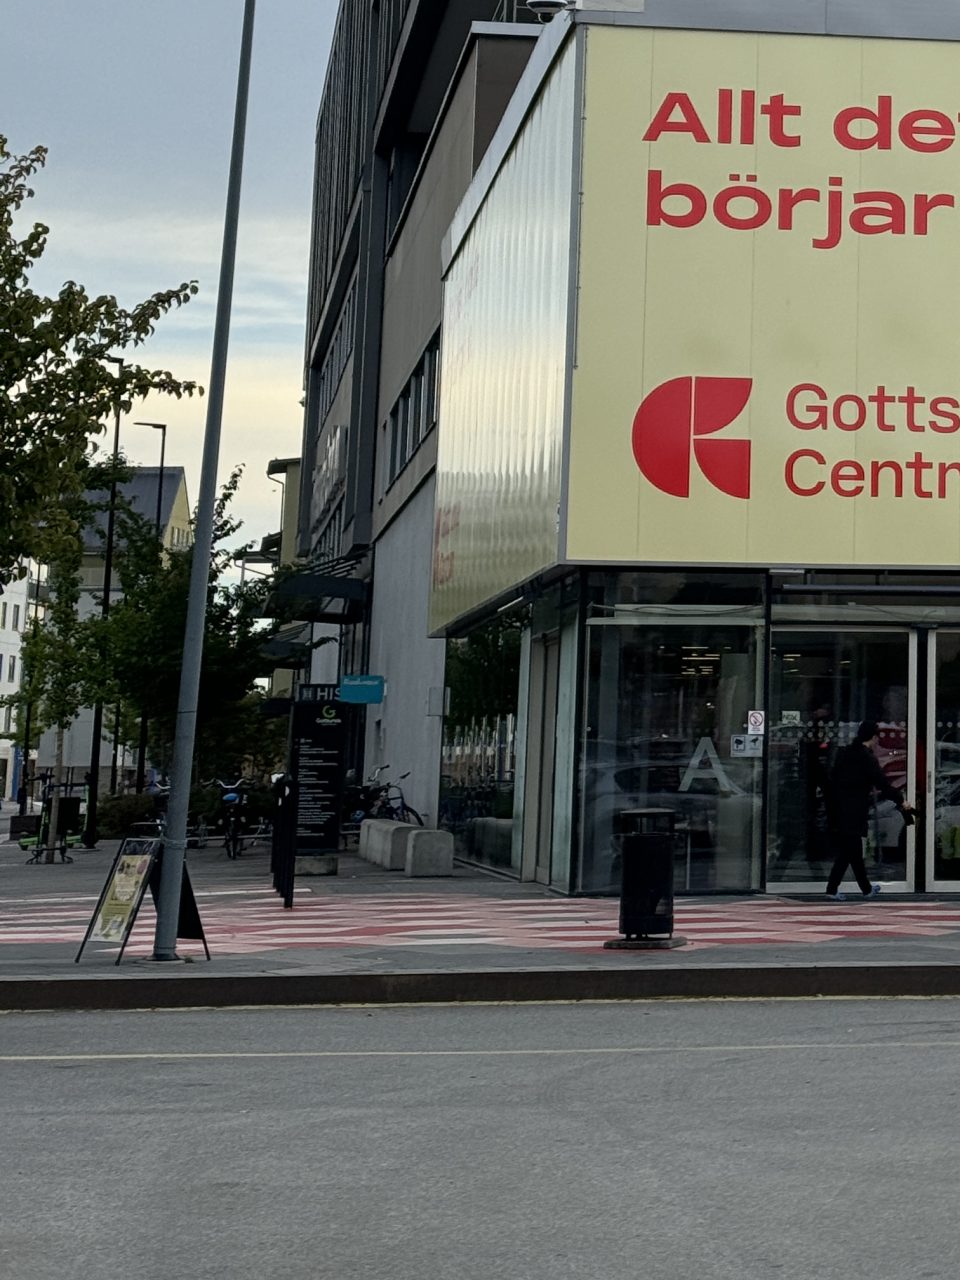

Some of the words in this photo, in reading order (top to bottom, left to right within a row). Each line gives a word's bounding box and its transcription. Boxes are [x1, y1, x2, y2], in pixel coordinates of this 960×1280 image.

[641, 88, 801, 148] Allt
[646, 170, 955, 249] börjar
[678, 736, 731, 792] A
